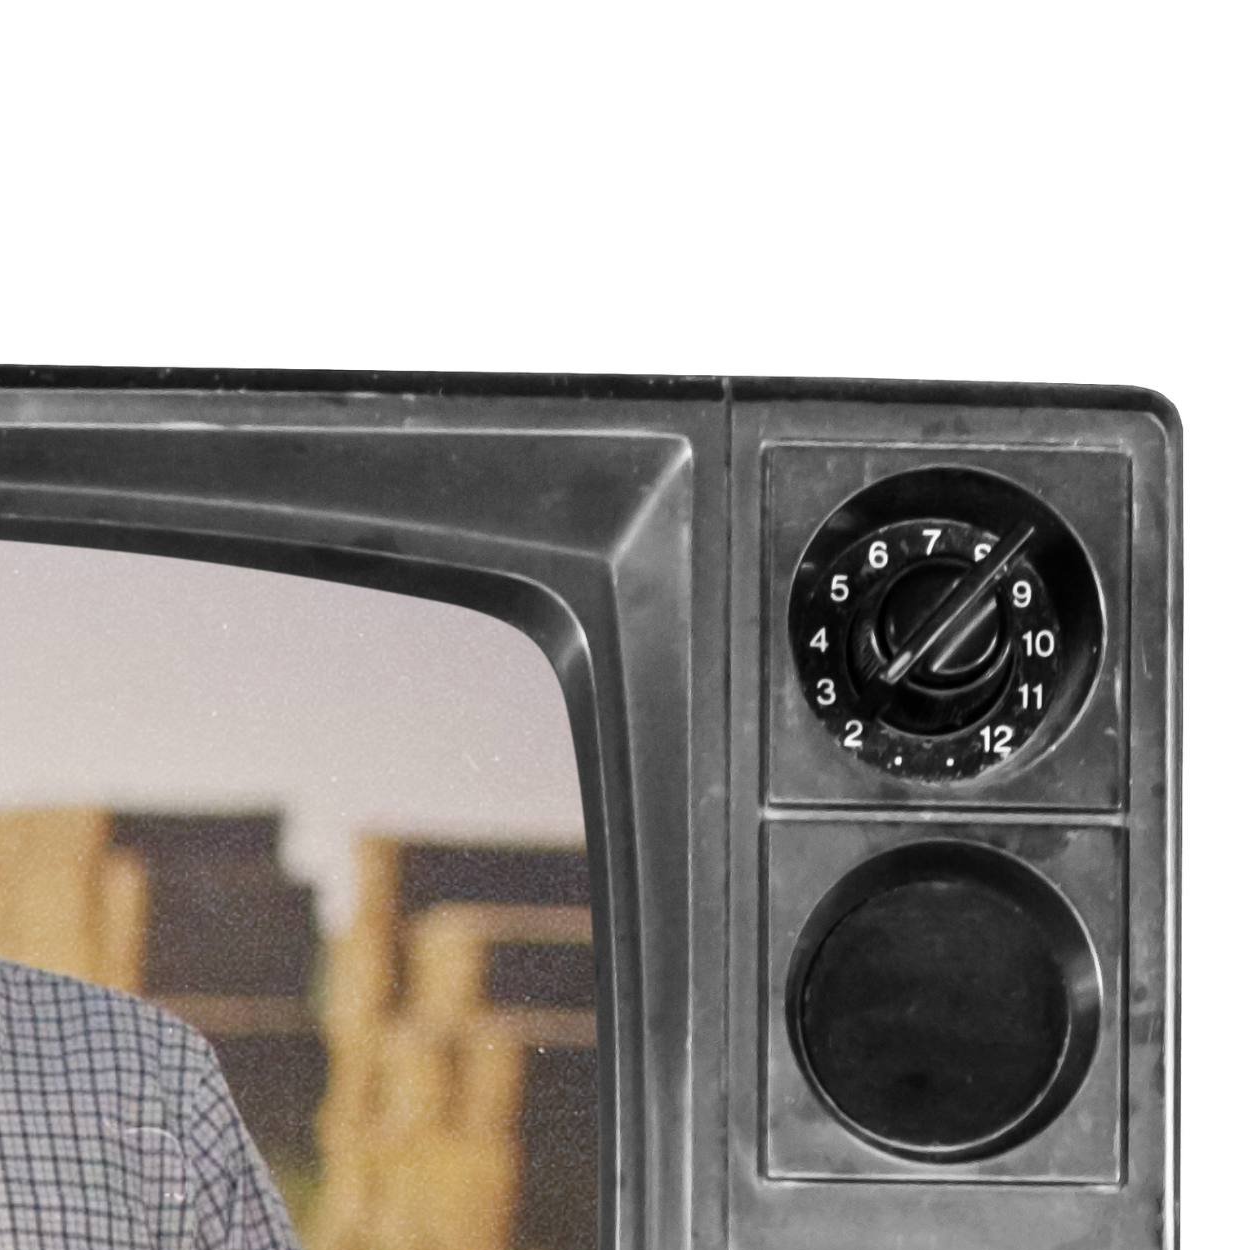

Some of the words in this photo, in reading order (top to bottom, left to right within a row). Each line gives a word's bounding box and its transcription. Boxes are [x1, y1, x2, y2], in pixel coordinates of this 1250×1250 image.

[868, 541, 889, 568] 6
[922, 529, 942, 555] 7
[830, 575, 849, 602] 5
[1012, 581, 1032, 608] 9
[809, 627, 829, 653] 4
[1022, 630, 1055, 658] 10
[816, 679, 836, 706] 3
[1018, 683, 1043, 710] 11
[843, 720, 864, 747] 2
[980, 725, 1014, 754] 12
